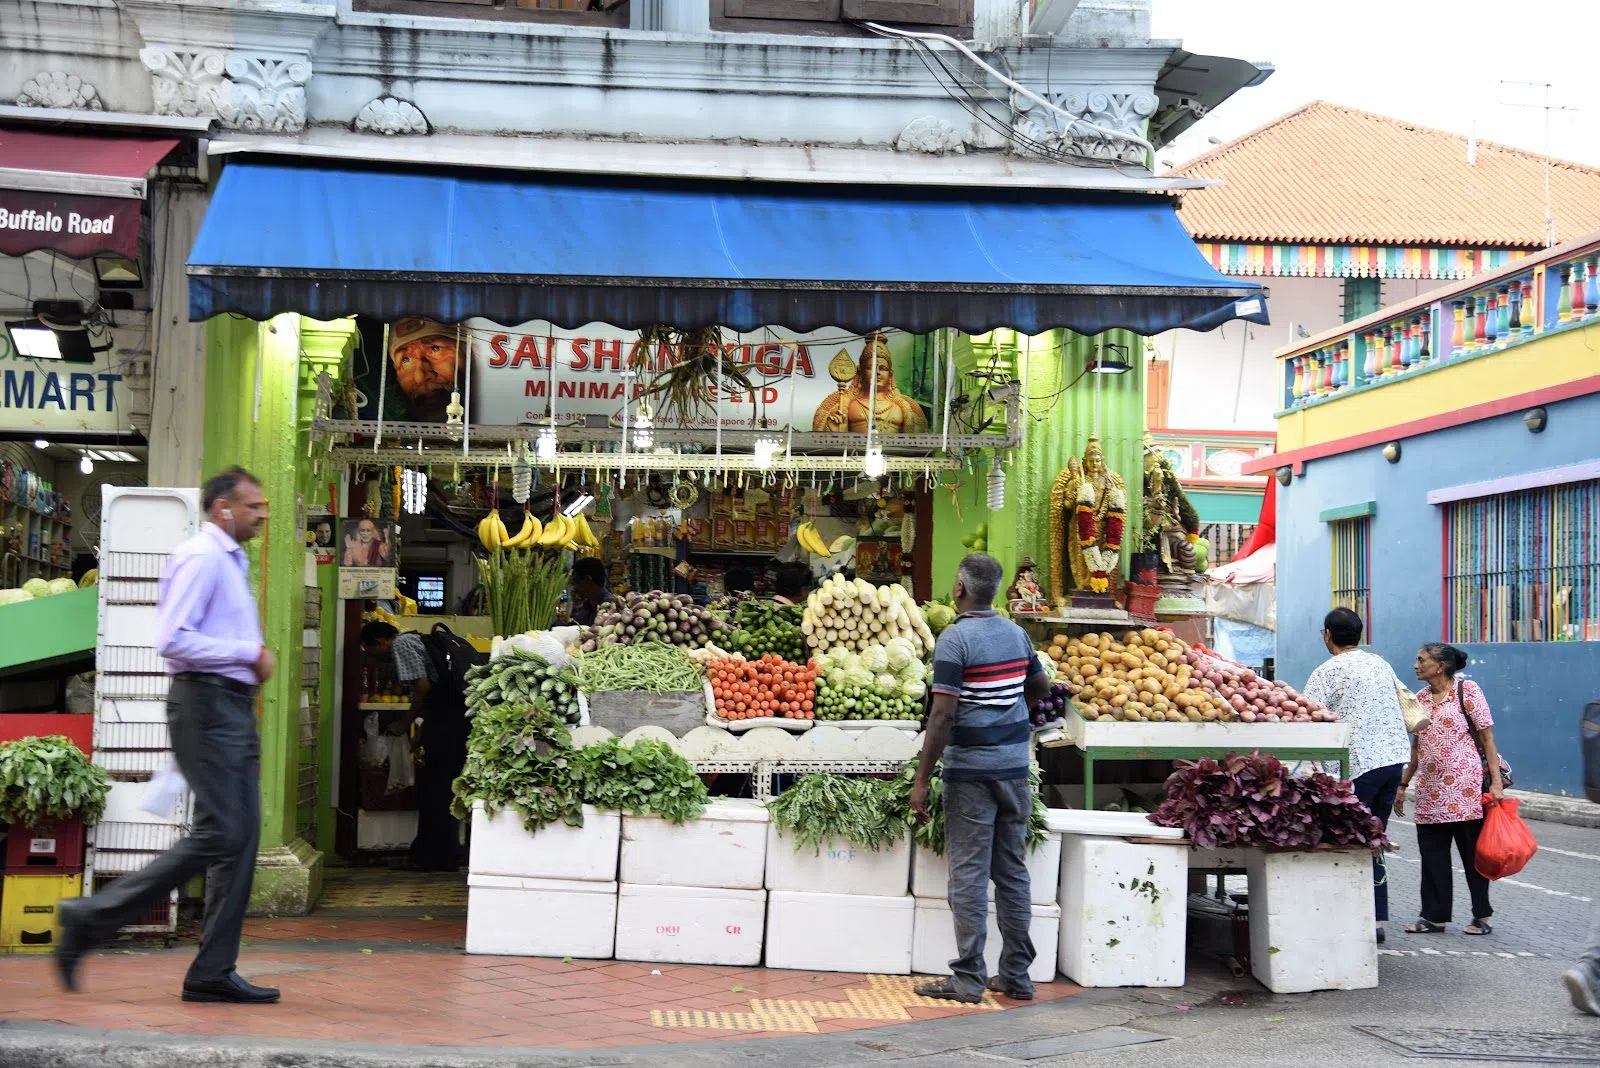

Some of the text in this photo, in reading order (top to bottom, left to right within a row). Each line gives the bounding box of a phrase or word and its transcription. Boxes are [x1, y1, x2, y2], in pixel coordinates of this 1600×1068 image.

[0, 208, 114, 234] Buffalo Road
[489, 334, 556, 368] SAI
[0, 369, 123, 412] MART
[525, 411, 564, 421] Conct:
